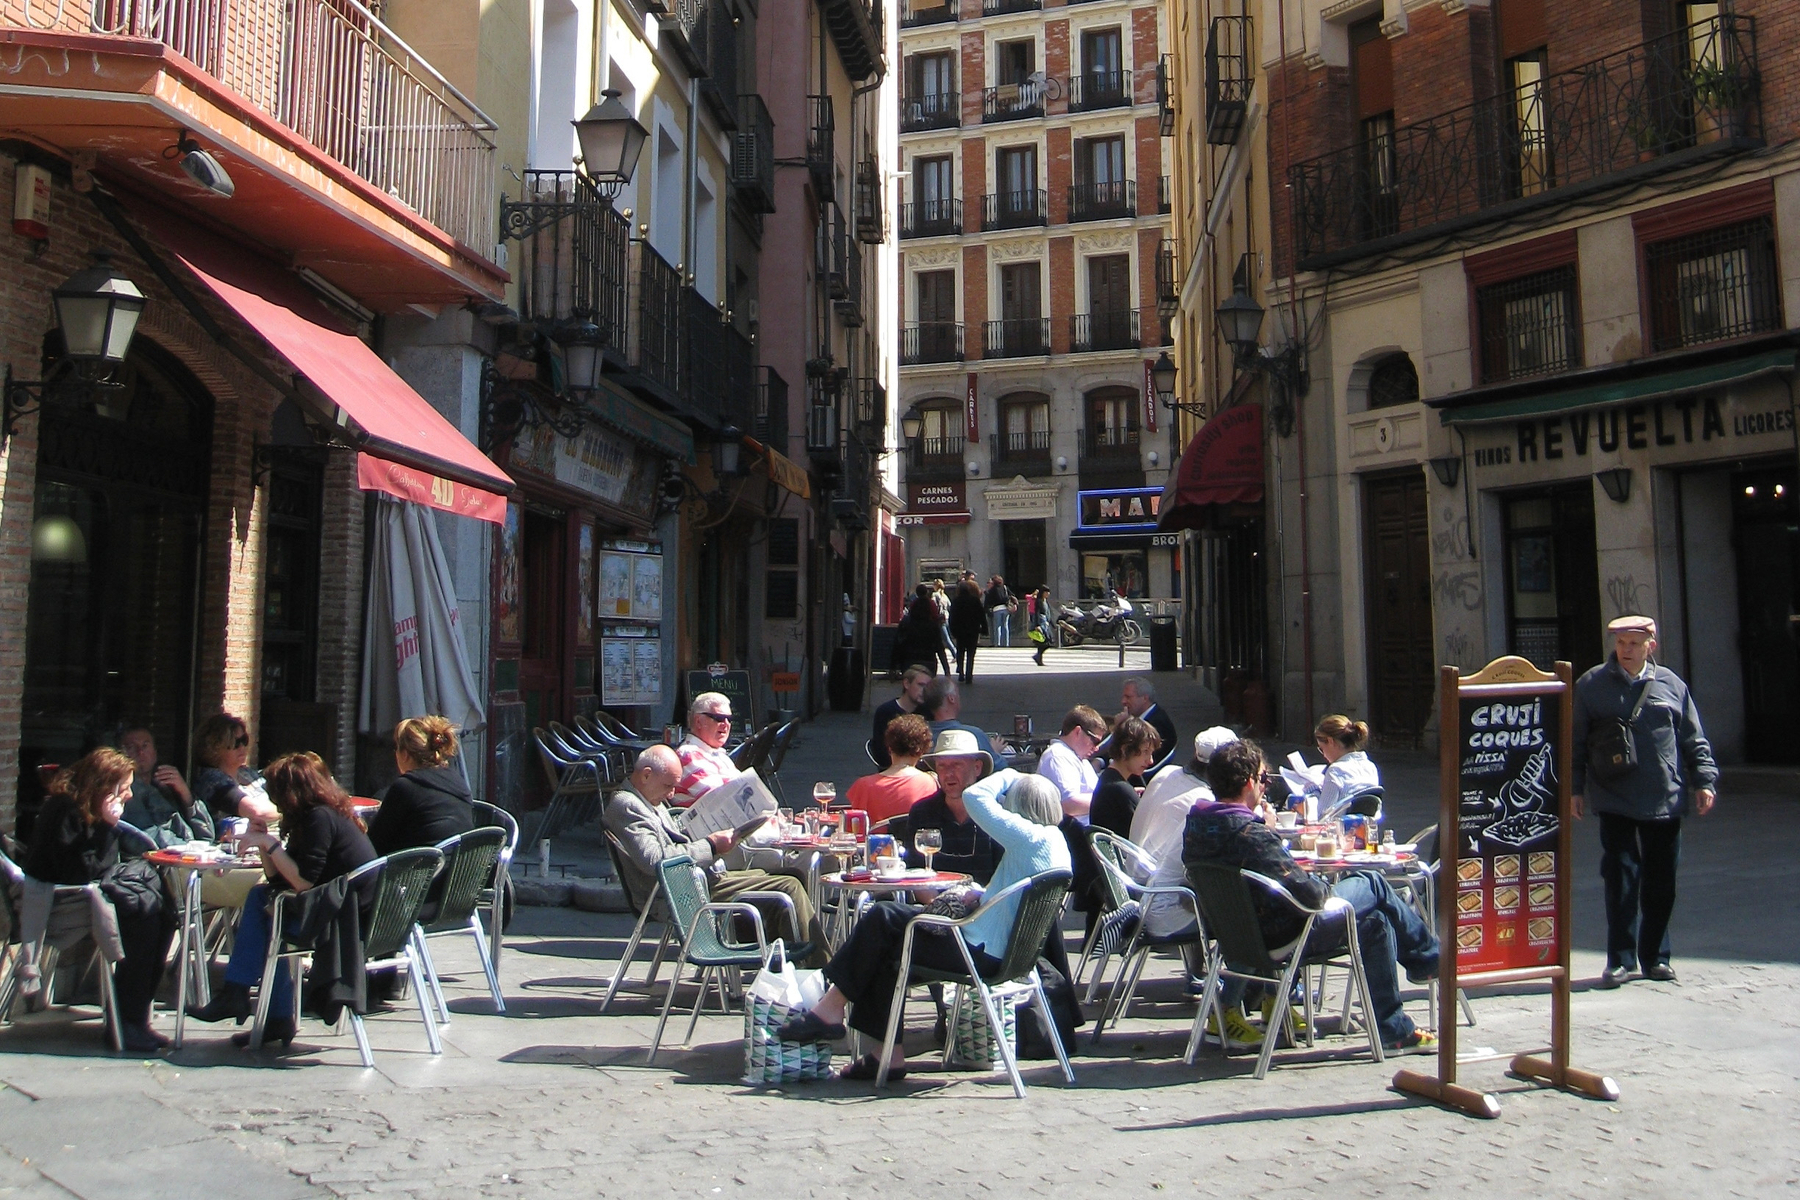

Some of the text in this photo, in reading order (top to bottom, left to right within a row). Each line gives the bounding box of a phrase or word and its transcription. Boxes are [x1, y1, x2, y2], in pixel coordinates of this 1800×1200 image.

[1221, 410, 1254, 430] shop
[1380, 427, 1387, 442] 3
[1475, 399, 1794, 468] VINOS REVUELTA LICORES
[921, 486, 953, 495] CARNES
[917, 495, 959, 504] PESCADOS
[1469, 728, 1544, 748] COQUES
